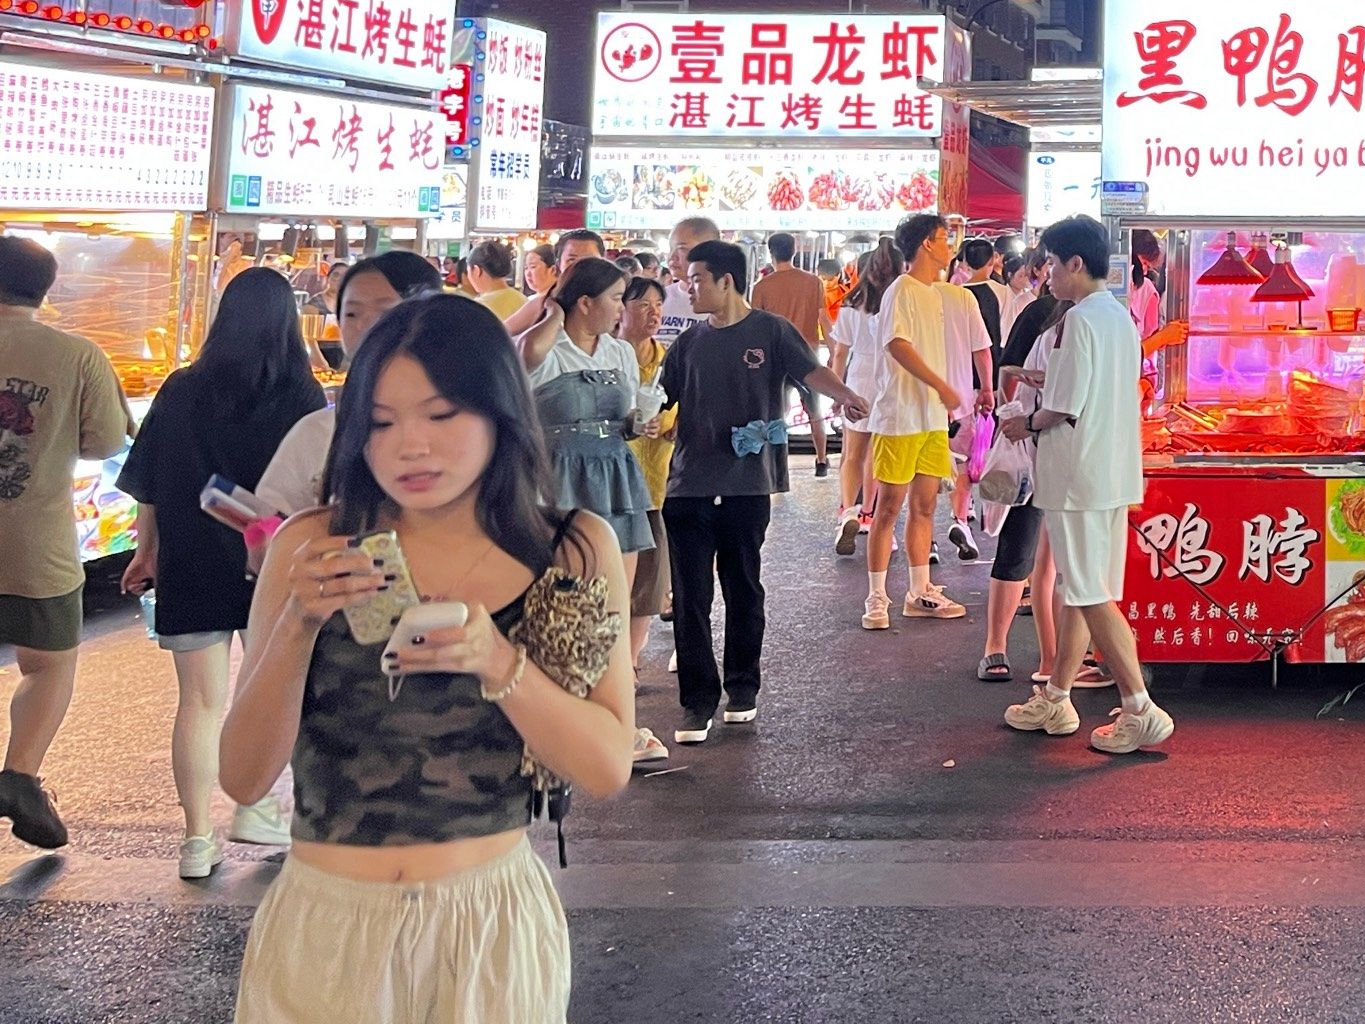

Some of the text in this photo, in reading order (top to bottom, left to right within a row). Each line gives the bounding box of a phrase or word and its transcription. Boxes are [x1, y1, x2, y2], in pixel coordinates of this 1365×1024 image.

[669, 20, 939, 86] 壹品龙虾
[669, 91, 935, 132] 湛江烤生蚝
[241, 93, 440, 174] 湛江烤生蚝
[1145, 138, 1201, 178] jing
[1209, 150, 1249, 169] wu
[1258, 138, 1304, 169] hei
[1313, 149, 1348, 178] ya
[1136, 502, 1320, 586] 鸭脖
[1128, 601, 1260, 621] 昌黑鸭 先甜后辣
[1152, 627, 1213, 646] 然后香!
